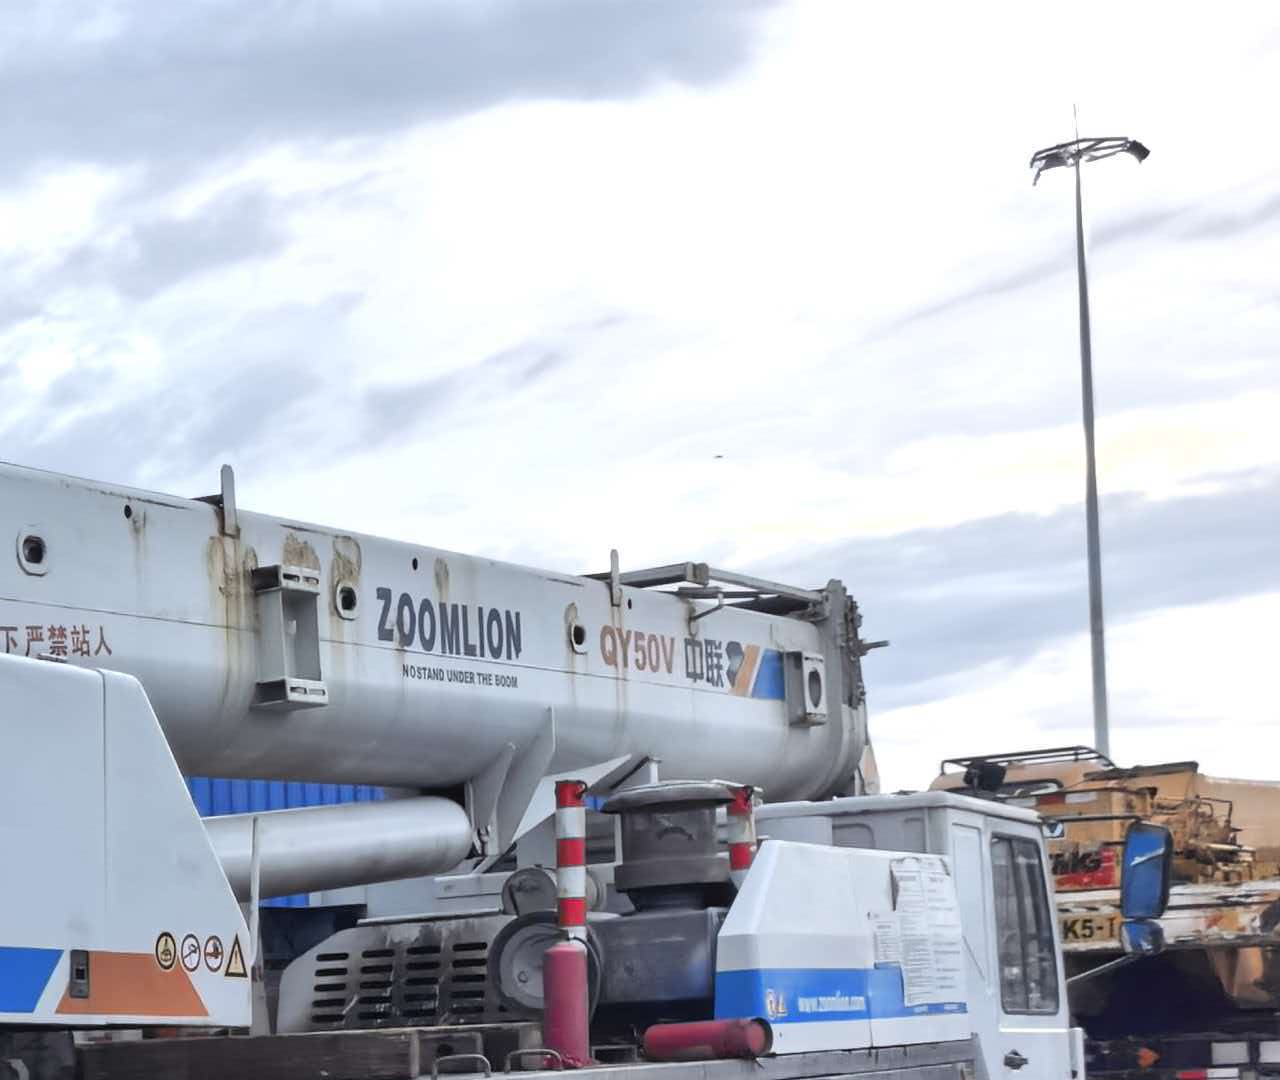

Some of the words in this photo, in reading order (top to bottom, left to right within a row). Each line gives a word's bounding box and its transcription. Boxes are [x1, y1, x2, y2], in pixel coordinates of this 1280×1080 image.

[376, 586, 522, 661] ZOOMLION
[600, 624, 676, 674] QY50V
[446, 669, 475, 685] UNDER
[477, 672, 493, 686] THE
[495, 675, 518, 689] BOOM
[684, 634, 724, 688] 中联
